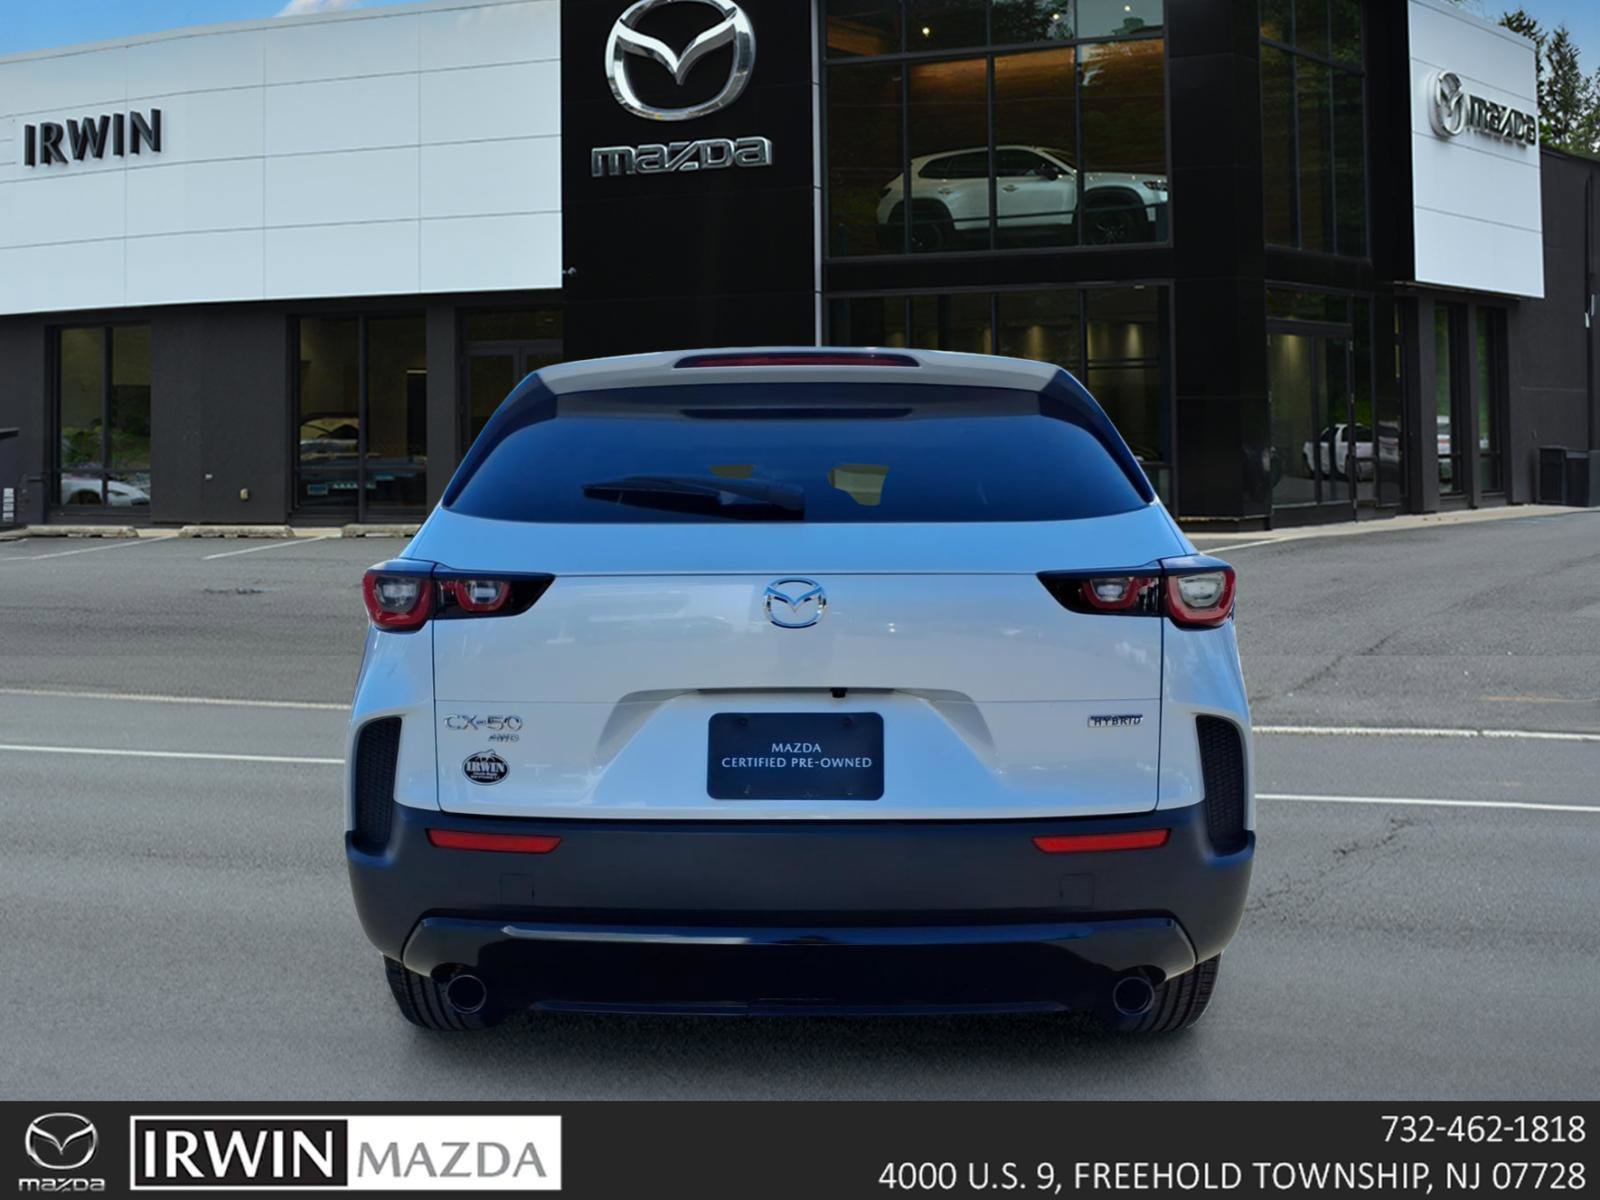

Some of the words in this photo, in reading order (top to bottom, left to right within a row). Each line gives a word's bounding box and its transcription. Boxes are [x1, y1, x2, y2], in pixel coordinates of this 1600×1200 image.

[24, 108, 162, 168] IRWIN
[444, 713, 523, 731] CX-50
[1090, 714, 1143, 727] HYBRID
[771, 743, 822, 753] MAZDA
[466, 760, 505, 773] IRWIN
[721, 757, 787, 768] CERTIFIED
[791, 757, 873, 768] PRE-OWNED
